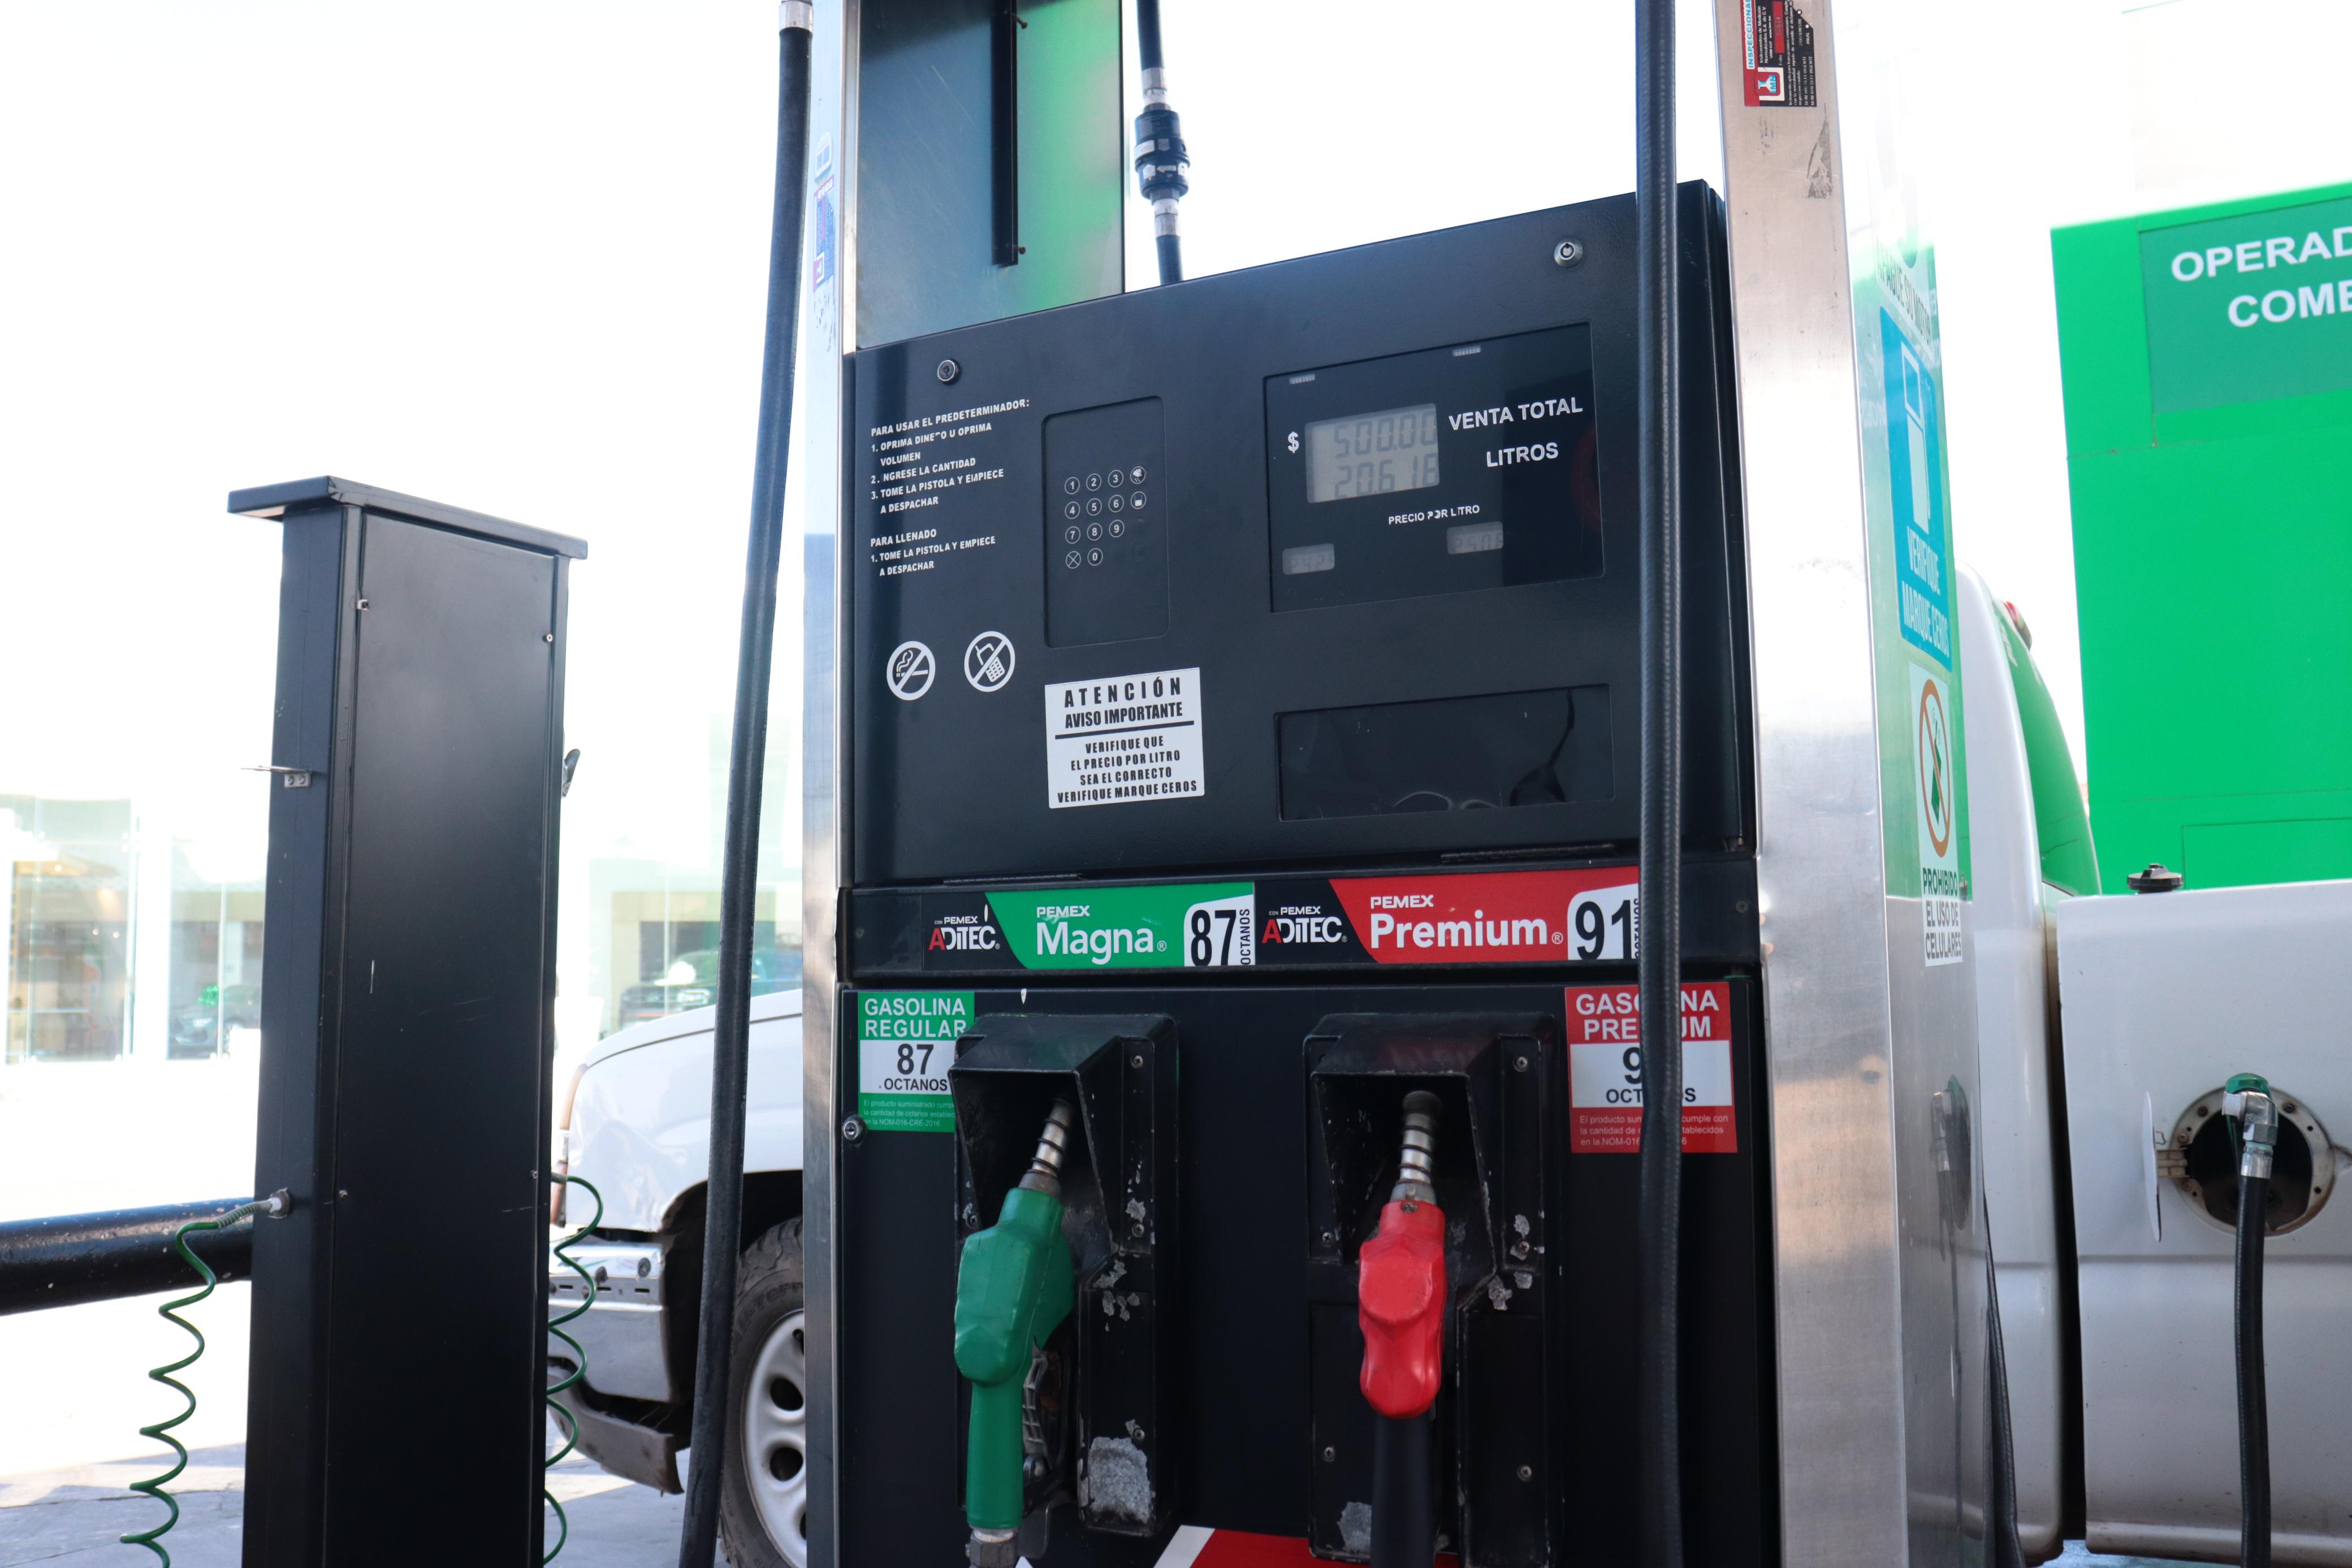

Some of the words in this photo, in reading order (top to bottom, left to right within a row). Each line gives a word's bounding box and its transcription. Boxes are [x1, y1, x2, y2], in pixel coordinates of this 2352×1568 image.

[871, 425, 893, 436] PARA
[896, 419, 919, 432] USAR
[922, 418, 933, 427] EL
[936, 399, 1030, 424] PREDETERMINADOR:
[1449, 406, 1514, 431] VENTA
[1518, 397, 1583, 421] TOTAL
[880, 438, 913, 451] OPRIMA
[958, 423, 992, 436] OPRIMA
[1287, 431, 1299, 453] $
[880, 452, 921, 466] VOLUMEN
[1486, 442, 1559, 467] LITROS
[871, 475, 879, 484] 2.
[919, 465, 929, 475] LA
[932, 458, 976, 473] CANTIDAD
[871, 491, 878, 500] 3.
[881, 486, 903, 498] TOME
[906, 484, 917, 494] LA
[919, 478, 954, 492] PISTOLA
[958, 476, 963, 485] Y
[966, 469, 1004, 483] EMPIECE
[1070, 480, 1075, 490] 1
[1091, 478, 1096, 487] 2
[1113, 474, 1118, 483] 3
[880, 505, 887, 514] A
[889, 496, 939, 513] DESPACHAR
[1070, 506, 1075, 514] 4
[1114, 499, 1118, 508] 6
[1389, 512, 1425, 525] PRECIO
[1427, 509, 1449, 520] POR
[871, 536, 893, 547] PARA
[896, 529, 936, 544] LLENADO
[1070, 531, 1075, 539] 7
[1092, 528, 1097, 536] 8
[1114, 525, 1119, 533] 9
[871, 554, 877, 562] 1.
[880, 550, 901, 561] TOME
[903, 547, 914, 557] LA
[916, 543, 950, 556] PISTOLA
[952, 541, 957, 549] Y
[960, 536, 996, 549] EMPIECE
[1092, 552, 1098, 561] 0
[880, 568, 885, 577] A
[887, 561, 934, 575] DESPACHAR
[1064, 677, 1181, 708] ATENCIÓN
[1065, 711, 1101, 729] AVISO
[1104, 702, 1183, 724] IMPORTANTE
[1086, 738, 1140, 754] VERIFIQUE
[1143, 736, 1164, 750] QUE
[1071, 760, 1081, 771] EL
[1084, 756, 1122, 770] PRECIO
[1125, 753, 1146, 765] POR
[1149, 750, 1181, 763] LITRO
[1080, 774, 1099, 786] SEA
[1102, 773, 1112, 783] EL
[1115, 766, 1171, 782] CORRECTO
[1057, 788, 1112, 803] VERIFIQUE
[1115, 783, 1158, 798] MARQUE
[1161, 780, 1197, 794] CEROS
[1922, 868, 1958, 896] PROHIBIDO
[1036, 904, 1090, 918] PEMEX
[1280, 906, 1321, 916] PEMEX
[1370, 895, 1434, 909] PEMEX
[944, 916, 978, 925] PEMEX
[1926, 900, 1936, 927] EL
[1936, 901, 1949, 927] USO
[1951, 902, 1959, 927] DE
[1191, 909, 1236, 967] 87
[1239, 909, 1251, 965] OCTANOS
[1370, 910, 1547, 948] Premium
[1575, 900, 1632, 960] 91
[1036, 922, 1153, 965] Magna
[1925, 932, 1962, 960] CELULARES
[864, 998, 966, 1016] GASOLINA
[1576, 990, 1719, 1015] GASNA
[865, 1020, 967, 1037] REGULAR
[1584, 1016, 1711, 1041] PREM
[897, 1043, 934, 1075] 87
[884, 1078, 948, 1091] OCTANOS
[1606, 1088, 1696, 1103] OCTS
[1590, 1116, 1625, 1125] producto
[1682, 1115, 1711, 1124] cumple
